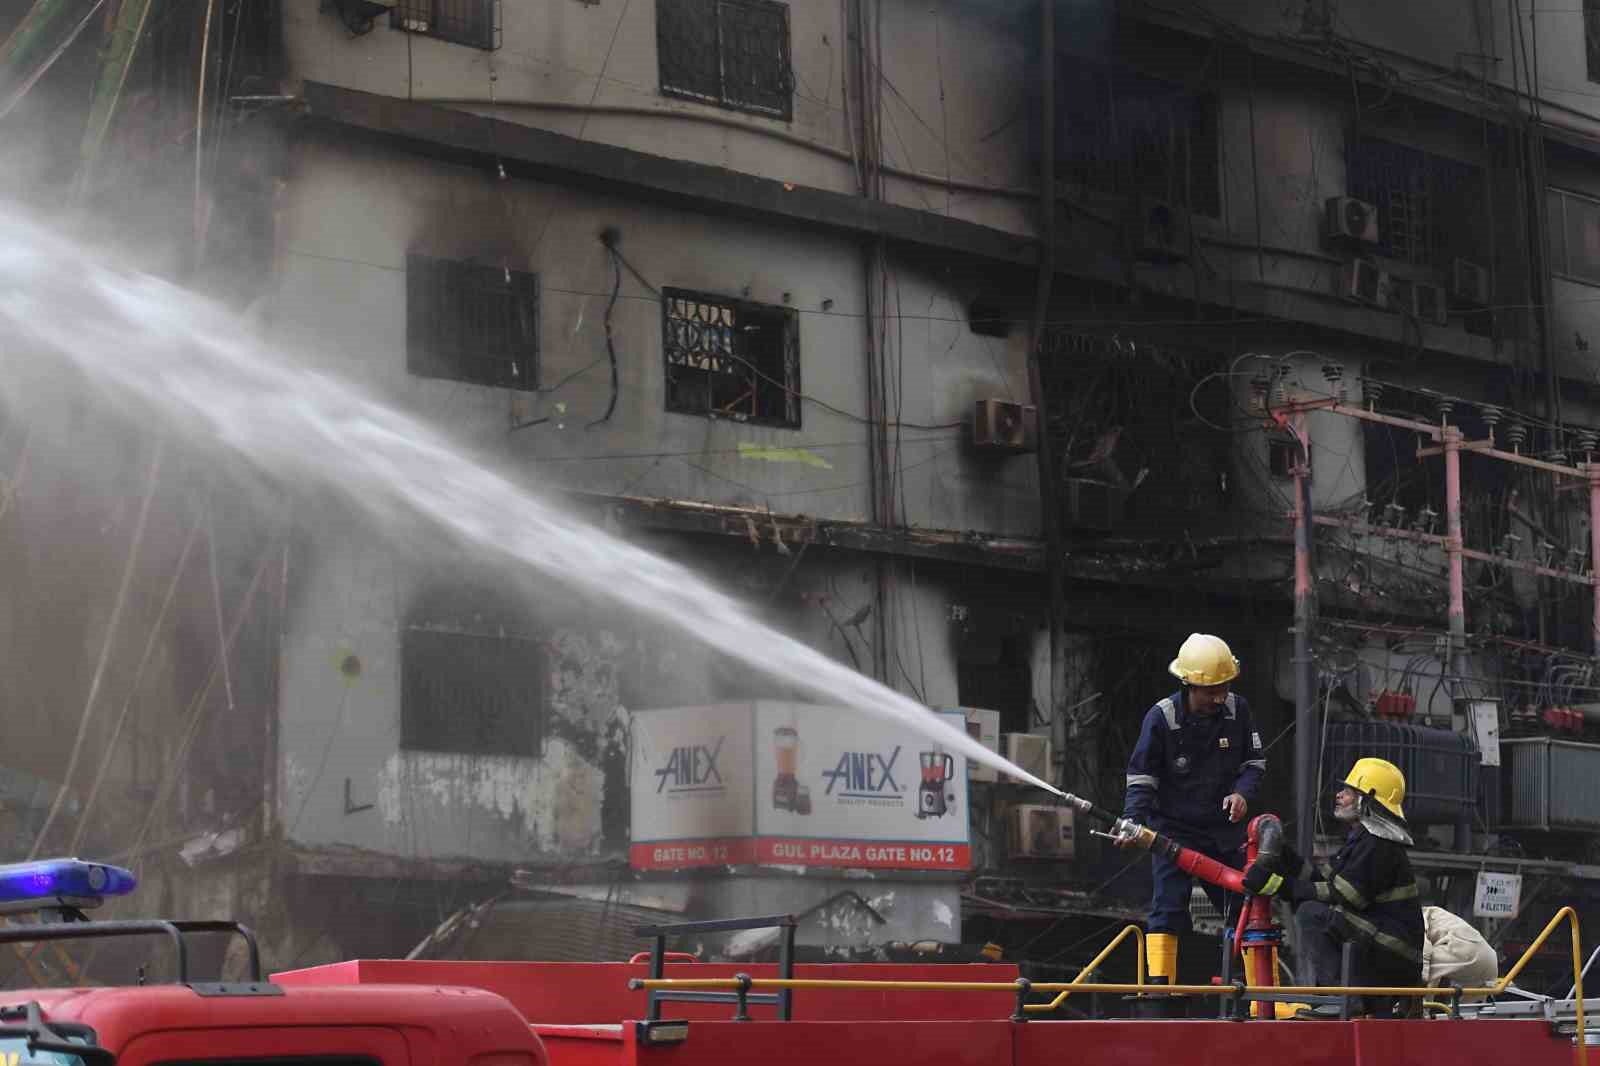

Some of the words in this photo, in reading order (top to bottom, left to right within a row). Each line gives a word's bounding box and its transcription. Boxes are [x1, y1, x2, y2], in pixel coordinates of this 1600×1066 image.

[655, 736, 726, 793] ANEX
[822, 745, 901, 795] ANEX
[654, 847, 684, 862] GATE
[772, 843, 805, 857] GUL
[810, 846, 859, 860] PLAZA
[866, 848, 905, 862] GATE
